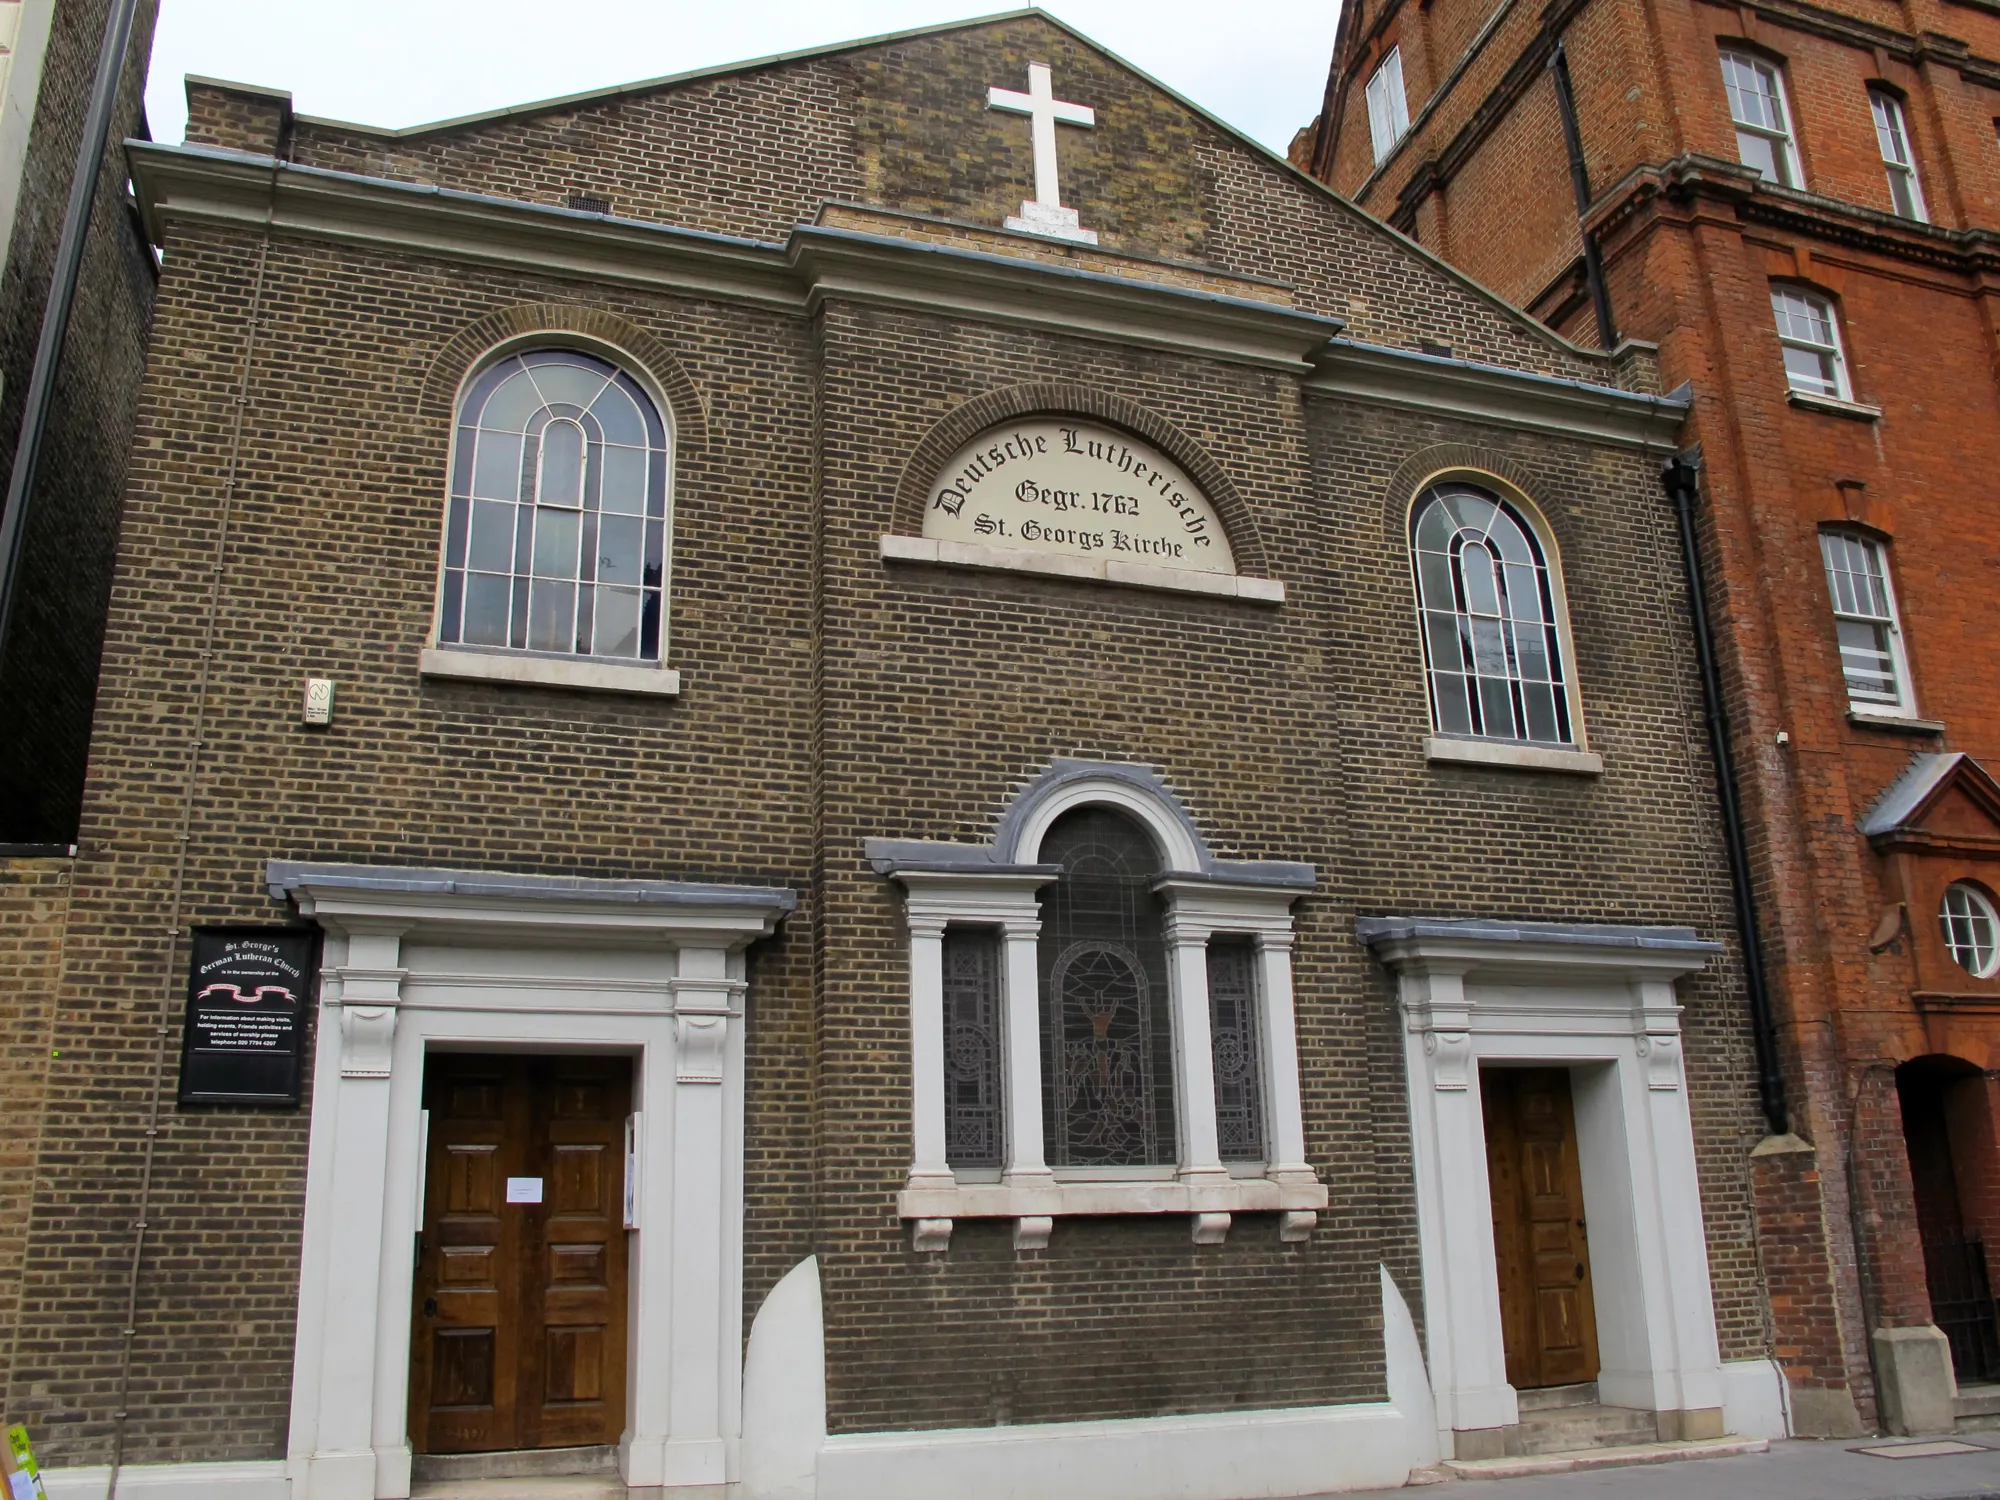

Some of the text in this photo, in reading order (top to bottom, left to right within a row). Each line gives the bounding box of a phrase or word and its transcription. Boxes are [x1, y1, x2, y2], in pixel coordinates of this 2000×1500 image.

[933, 428, 1211, 547] Deutsche Lutherische
[1015, 479, 1139, 515] Gegr. 1762
[974, 513, 1183, 558] St. Georgs Kirche
[225, 941, 279, 953] St. George's
[200, 953, 300, 978] German Lutheran Church
